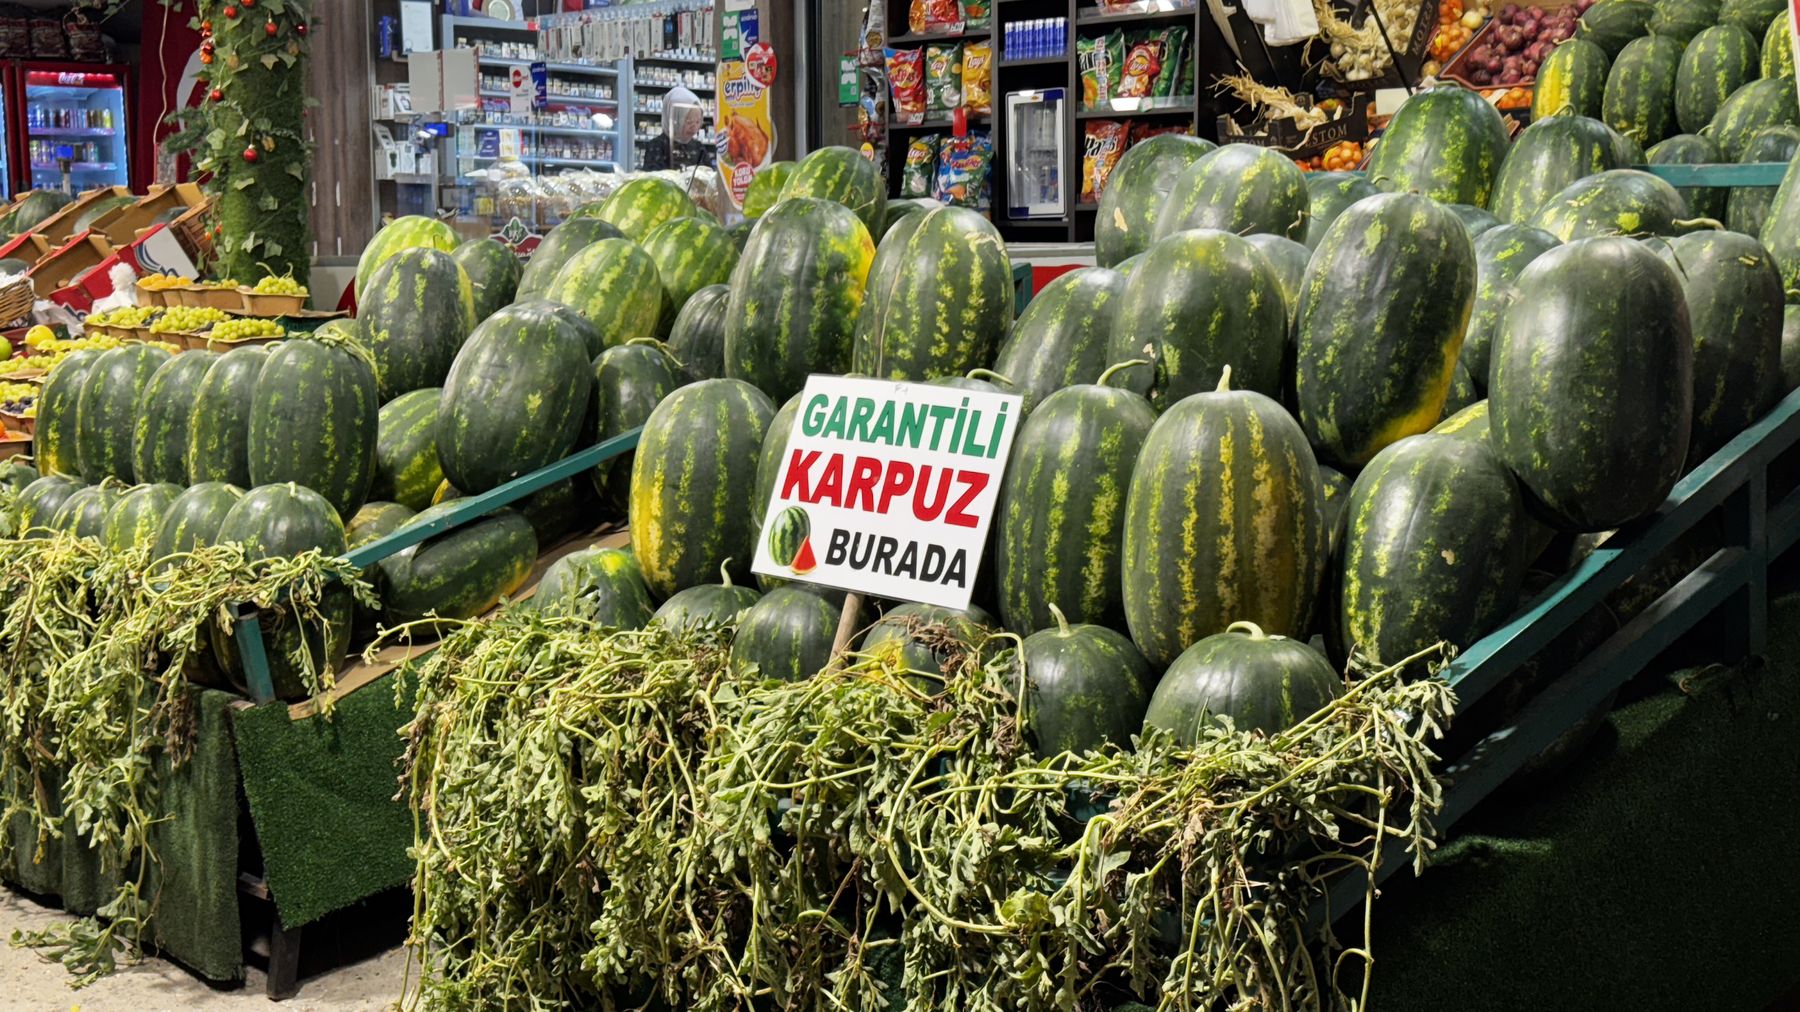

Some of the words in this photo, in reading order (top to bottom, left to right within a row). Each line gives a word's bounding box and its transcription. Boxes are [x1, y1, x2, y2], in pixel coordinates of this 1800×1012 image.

[802, 393, 1009, 459] GARANTİLİ
[780, 448, 990, 529] KARPUZ
[825, 528, 967, 589] BURADA
